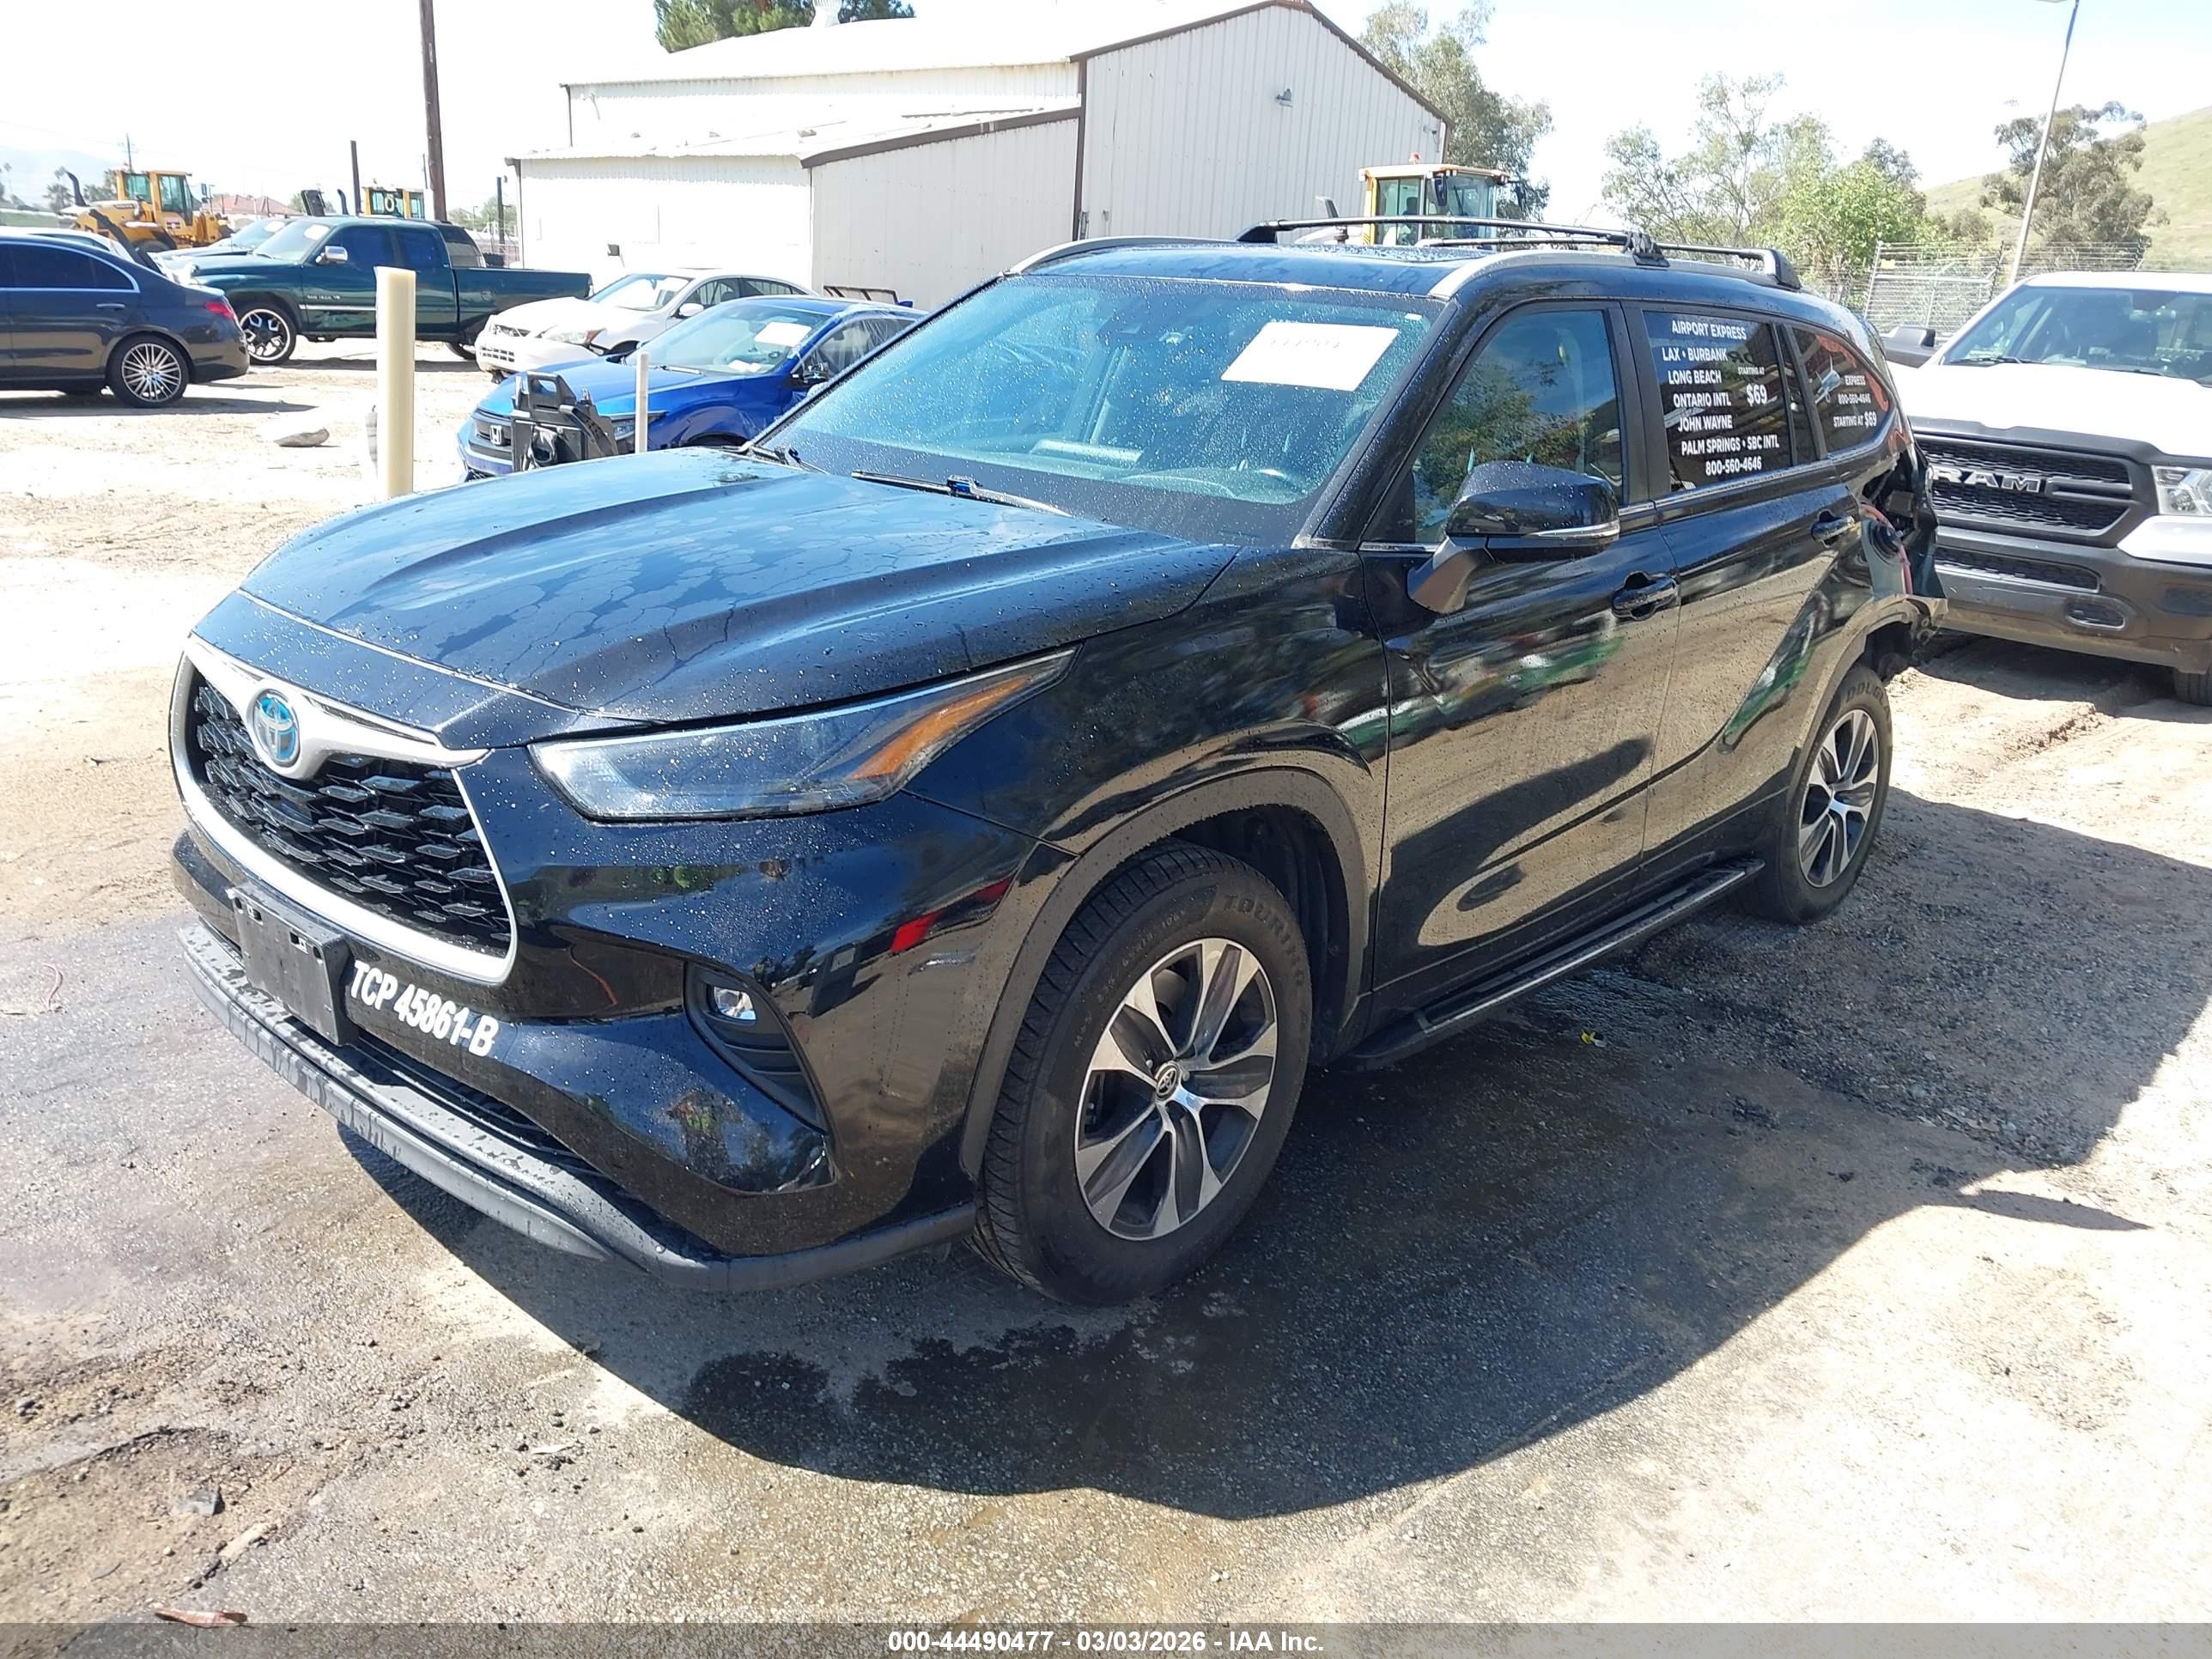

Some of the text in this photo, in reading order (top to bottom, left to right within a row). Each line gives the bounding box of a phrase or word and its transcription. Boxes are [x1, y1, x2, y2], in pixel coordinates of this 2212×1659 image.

[1672, 319, 1747, 340] AIRPORT EXPRESS
[1662, 347, 1729, 362] LAX BURBANK
[1668, 369, 1723, 385] LONG BEACH
[1737, 367, 1765, 375] STARTING AT
[1844, 374, 1866, 386] EXPRESS
[1673, 392, 1732, 408] ONTARIO INTL
[1746, 383, 1768, 407] $69
[1678, 414, 1733, 432] JOHN WAYNE
[1832, 410, 1877, 428] STARTING AT $69
[1681, 434, 1780, 456] PALM SPRINGS SBC INTL
[1705, 455, 1763, 477] 800-560-4646
[1929, 465, 2041, 494] RAM
[350, 959, 500, 1057] TCP 45861-B
